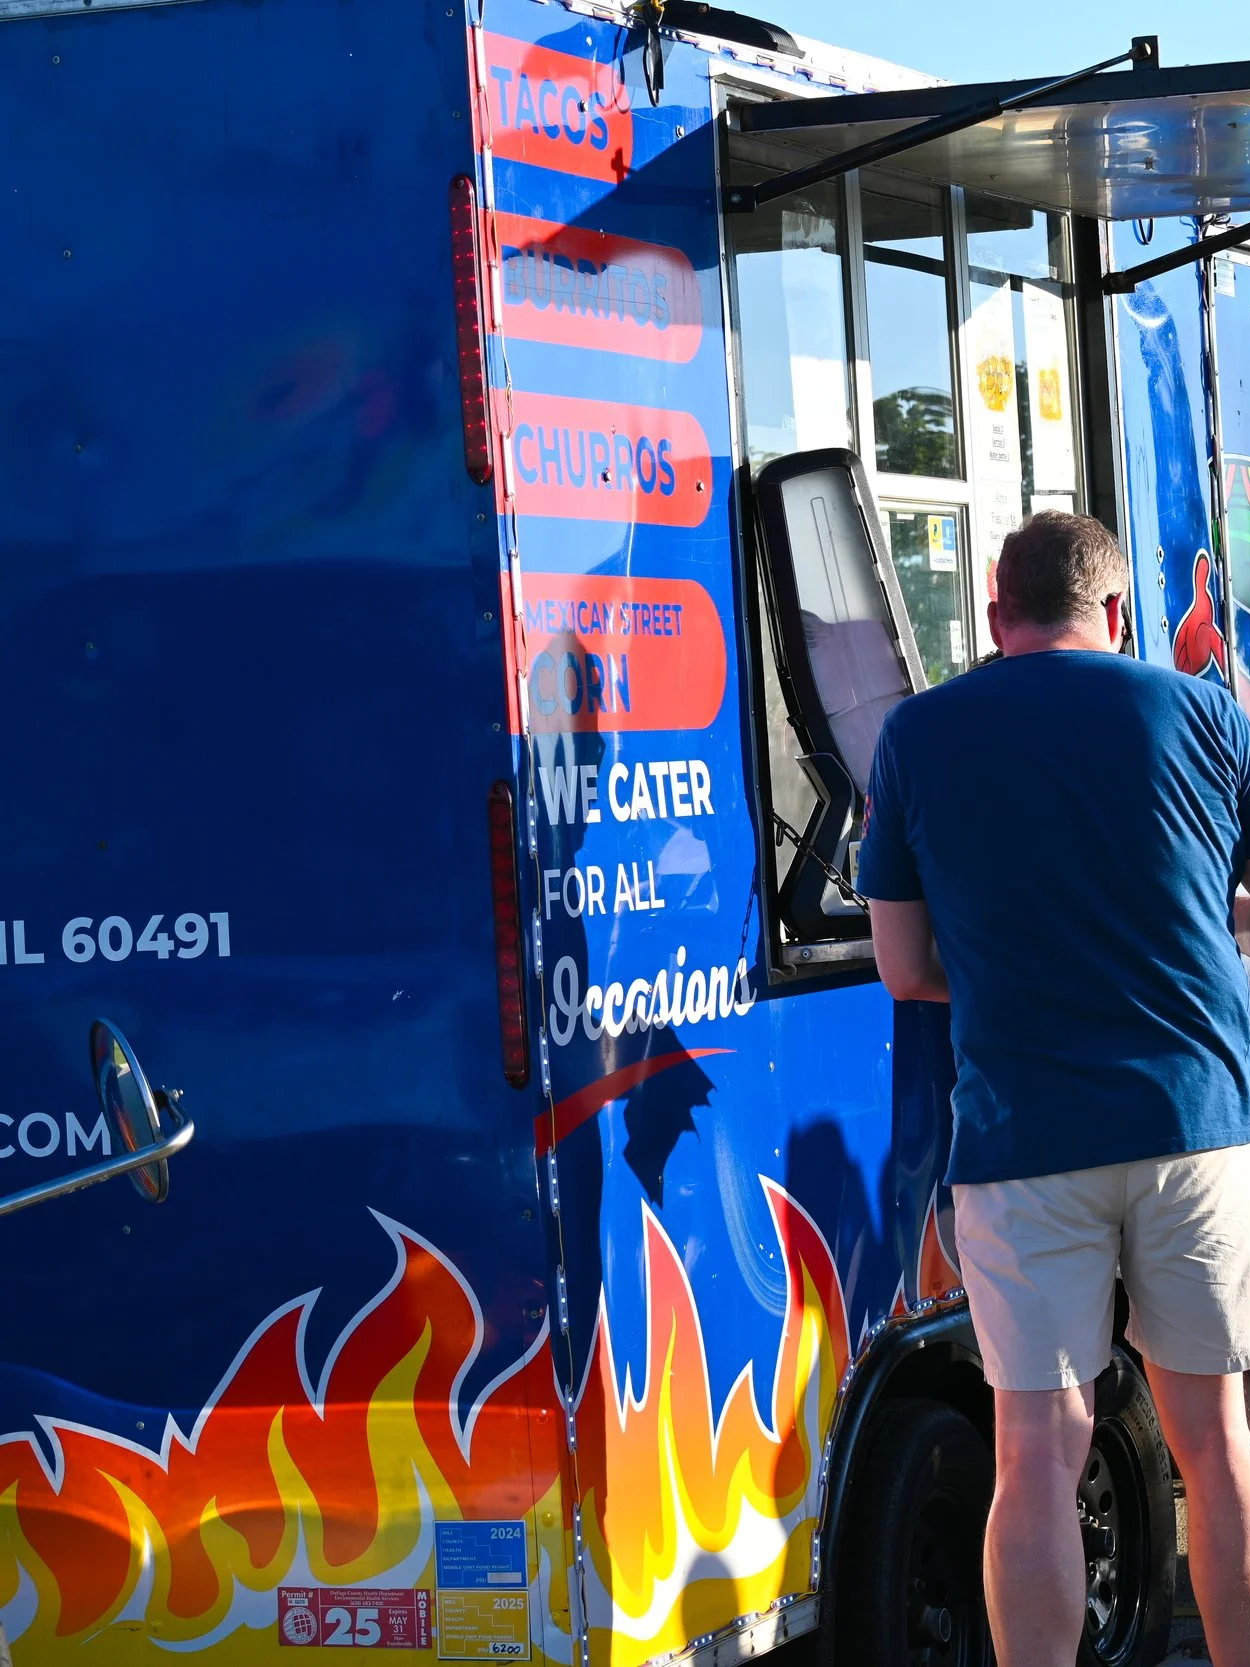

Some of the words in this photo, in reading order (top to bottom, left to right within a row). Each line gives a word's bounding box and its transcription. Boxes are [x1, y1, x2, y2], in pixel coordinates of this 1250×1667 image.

[489, 65, 610, 151] TACOS
[501, 244, 671, 331] BURRITOS
[512, 421, 676, 497] CHURROS
[525, 599, 616, 636] MEXICAN
[620, 602, 683, 637] STREET
[530, 652, 631, 717] CORN
[539, 764, 602, 826] WE
[608, 759, 715, 823] CATER
[543, 863, 607, 921] FOR
[613, 860, 665, 913] ALL
[61, 911, 231, 964] 60491
[550, 945, 758, 1047] Occasions
[490, 1527, 521, 1540] 2024
[281, 1590, 306, 1598] Permit
[389, 1616, 408, 1625] MAY
[417, 1591, 427, 1646] MOBILE
[493, 1598, 524, 1610] 2025
[324, 1607, 382, 1646] 25
[393, 1625, 403, 1633] 31
[492, 1643, 521, 1655] 6200
